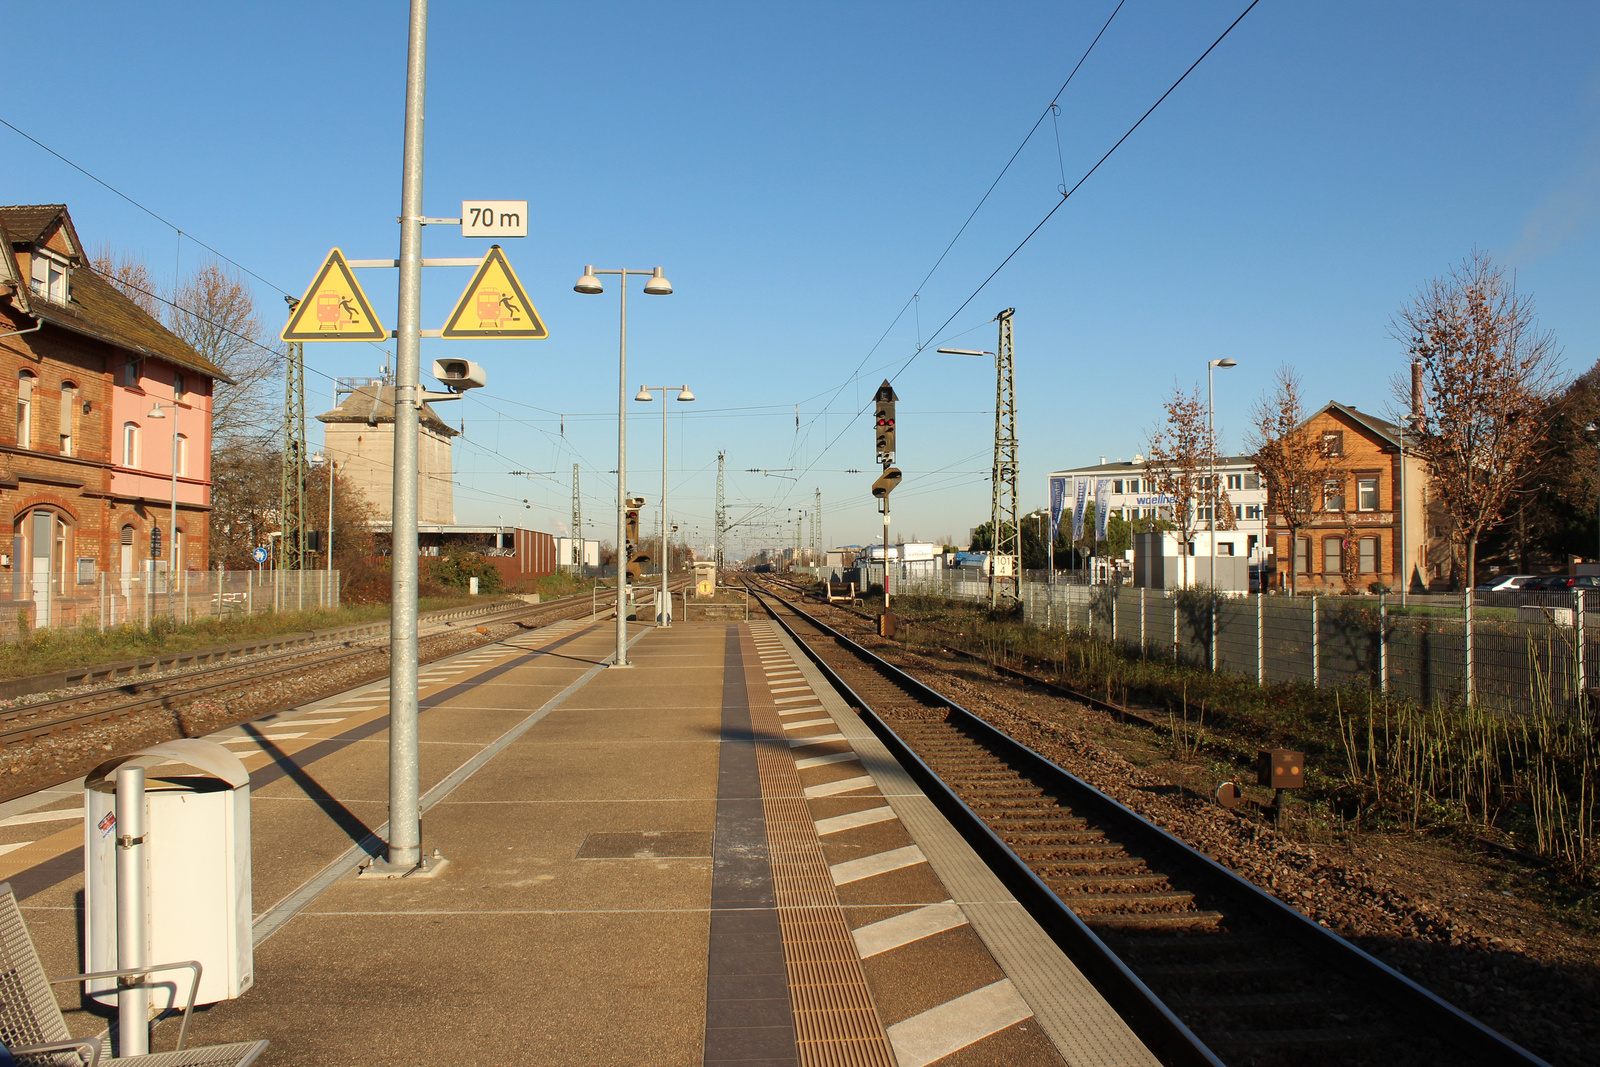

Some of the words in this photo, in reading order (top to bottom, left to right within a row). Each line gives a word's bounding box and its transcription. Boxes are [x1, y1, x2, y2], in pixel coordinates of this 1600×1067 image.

[470, 208, 494, 227] 70
[500, 213, 520, 227] m
[996, 556, 1011, 566] 101
[1000, 566, 1006, 574] 4
